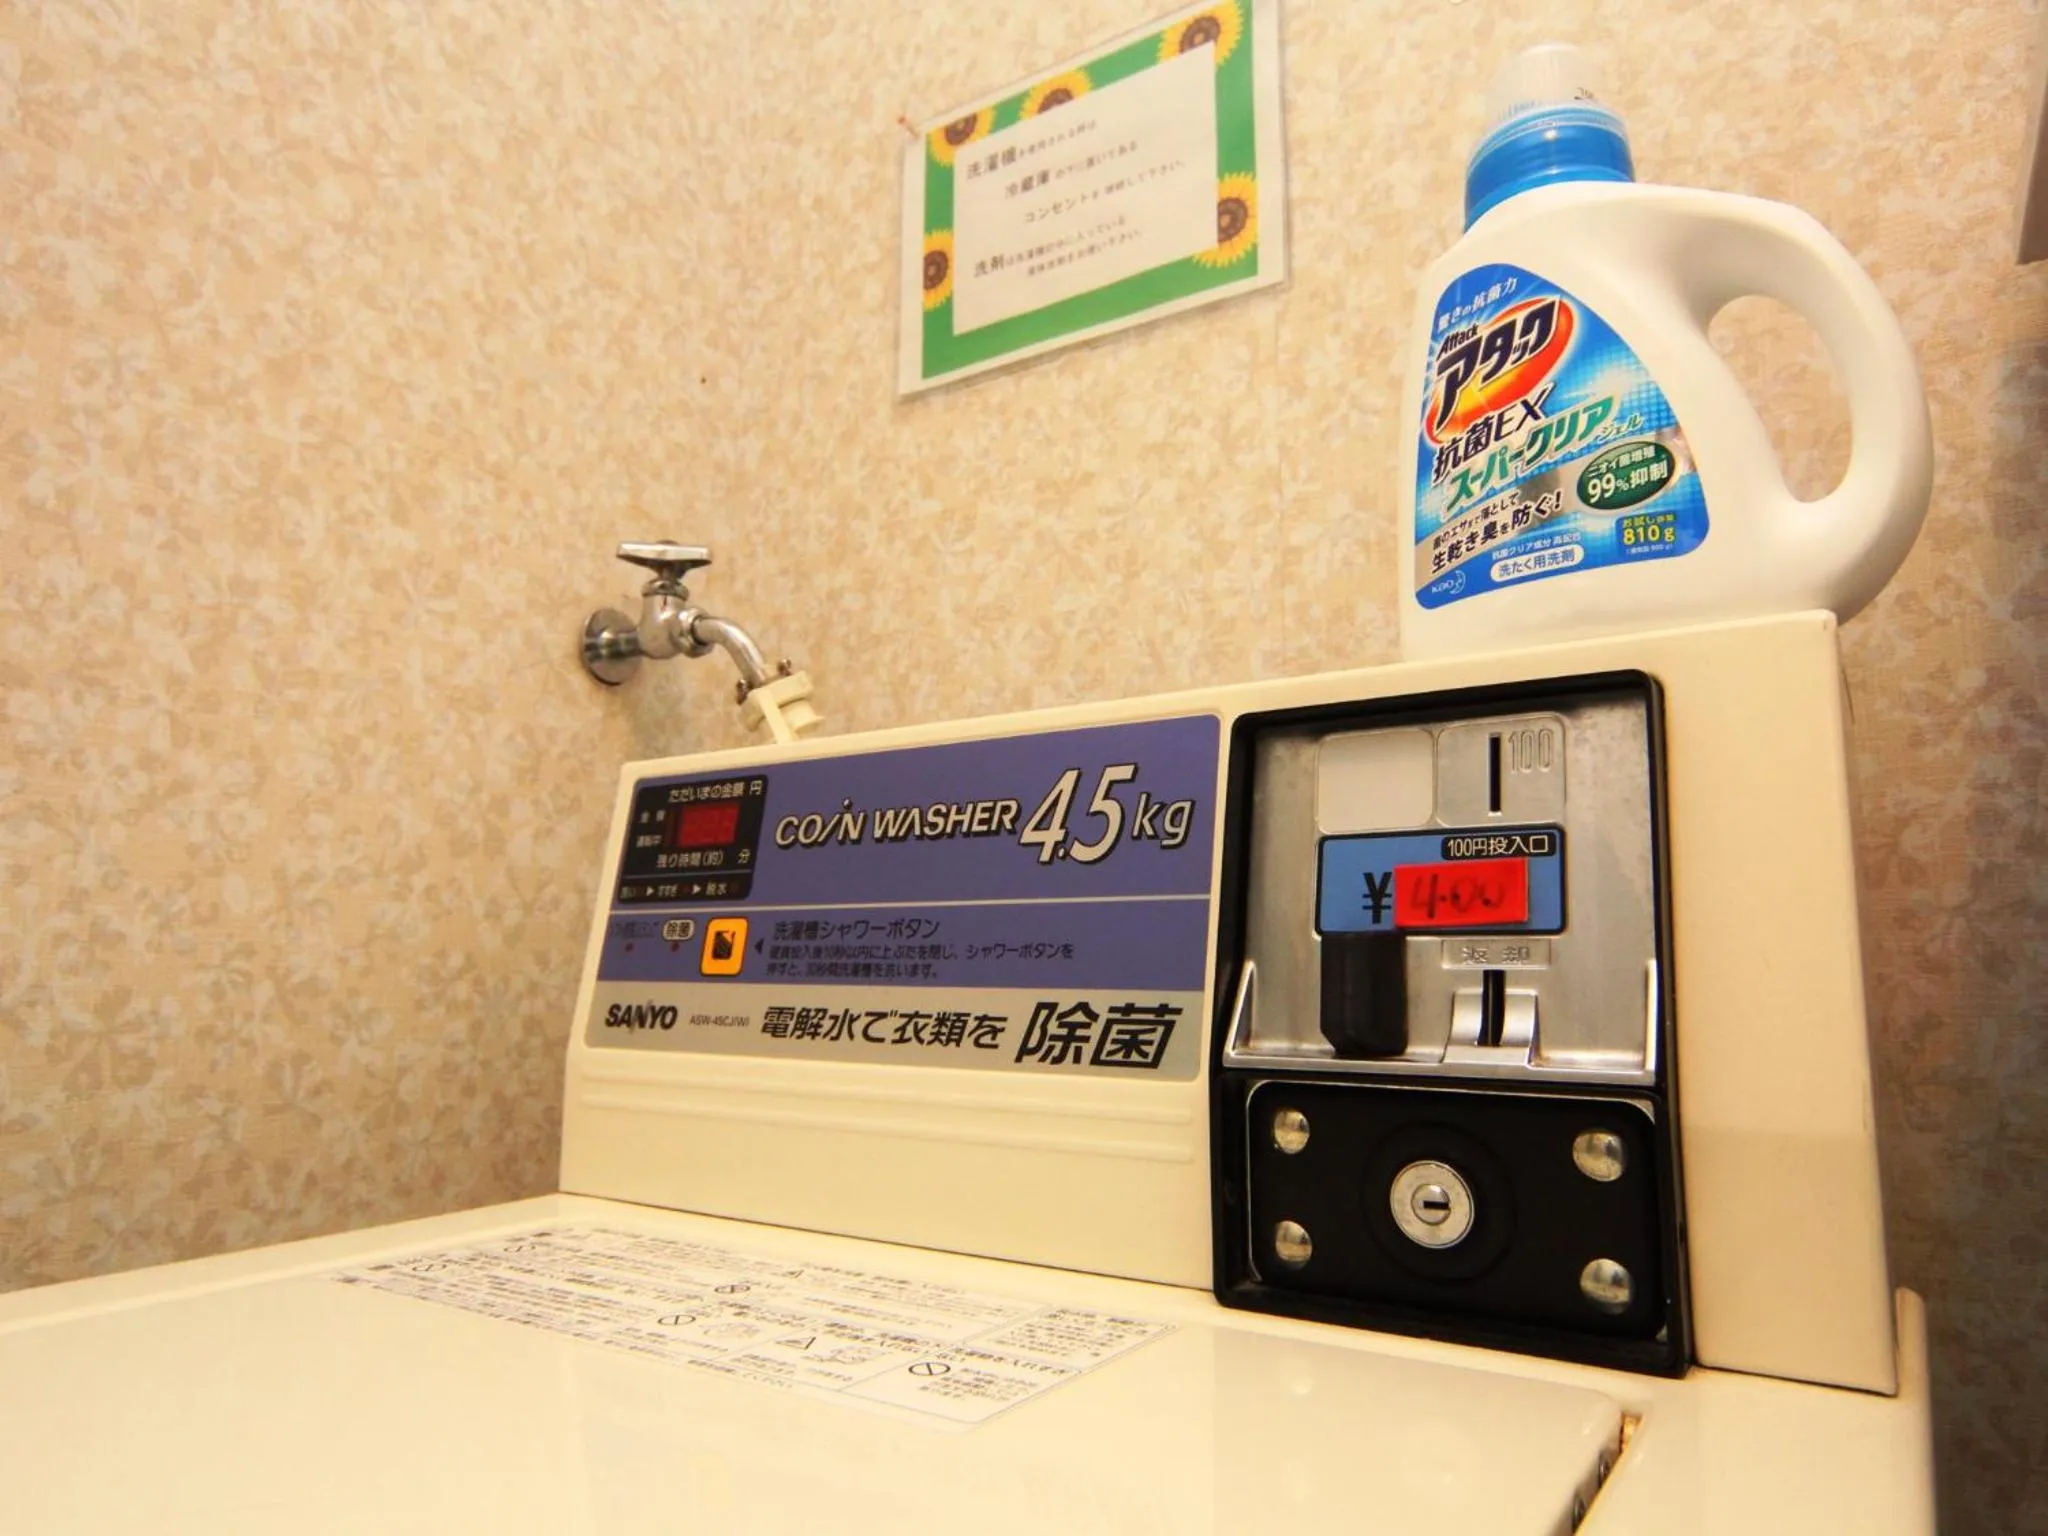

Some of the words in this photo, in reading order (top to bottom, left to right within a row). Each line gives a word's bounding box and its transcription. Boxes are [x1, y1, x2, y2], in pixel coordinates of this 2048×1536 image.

[1436, 321, 1480, 361] Attack
[1436, 299, 1557, 431] アタック
[1433, 384, 1554, 483] 抗菌EX
[1447, 396, 1614, 512] スーパークリア
[1499, 549, 1576, 577] 洗たく用洗剤
[1508, 728, 1554, 774] 100
[668, 781, 746, 803] ただいまの金額
[749, 780, 763, 796] 円
[775, 798, 868, 850] COIN
[873, 798, 1022, 844] WASHER
[738, 848, 751, 864] 分
[1447, 834, 1549, 858] 100円投入口
[664, 921, 691, 939] 除菌
[772, 918, 941, 942] 洗濯槽シャワーボタン
[605, 1002, 679, 1031] SANYO
[760, 1005, 1009, 1050] 電解水で衣類を
[1014, 1001, 1184, 1069] 除菌
